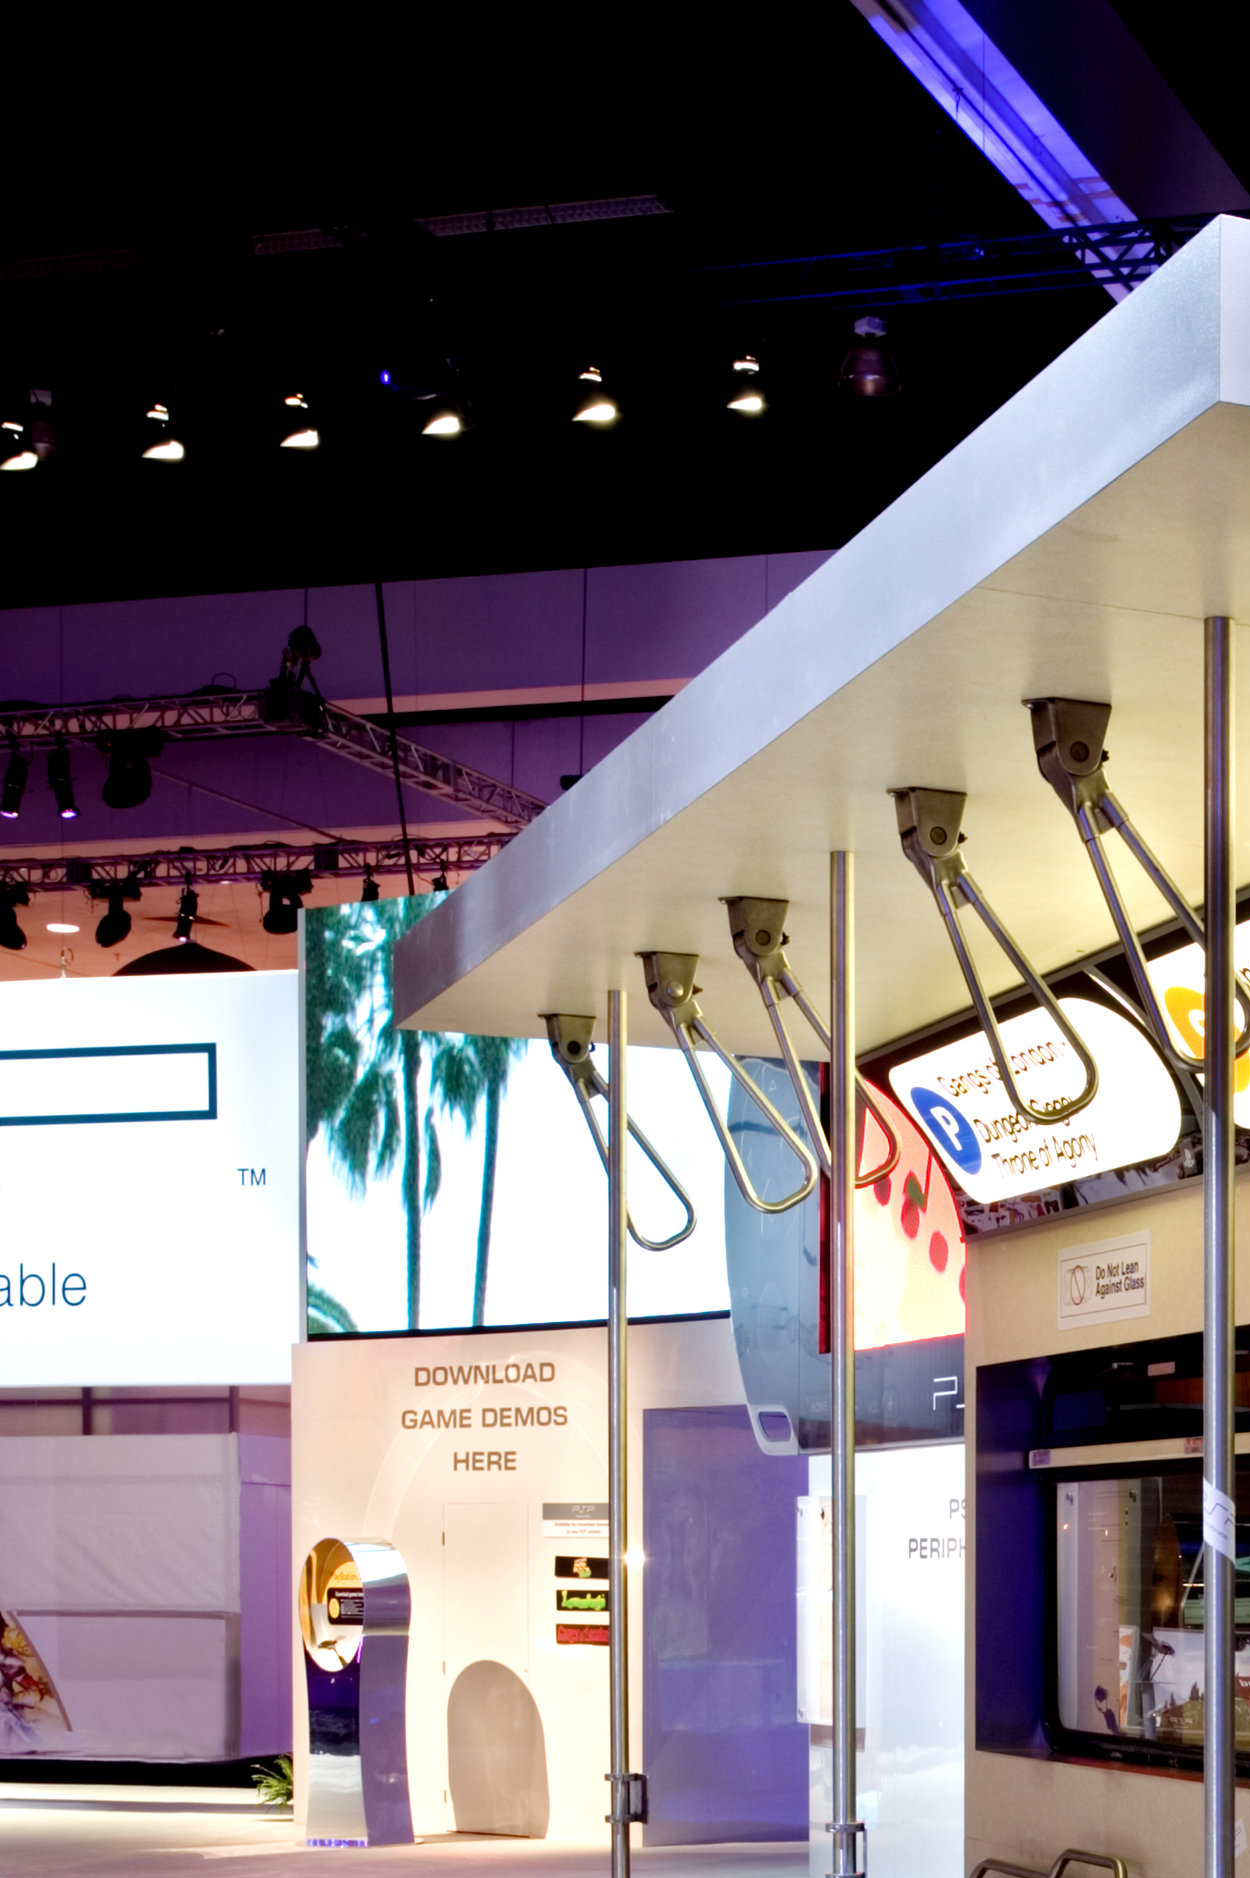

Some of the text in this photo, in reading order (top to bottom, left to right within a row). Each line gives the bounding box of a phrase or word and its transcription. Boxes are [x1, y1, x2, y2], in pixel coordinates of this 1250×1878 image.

[937, 1070, 991, 1097] Gangs
[930, 1106, 962, 1151] P
[991, 1132, 1098, 1178] Throne of Agony
[237, 1168, 267, 1186] TM
[1095, 1261, 1139, 1280] Do Not Lean
[0, 1262, 87, 1307] able
[1095, 1277, 1145, 1300] Against Glass
[414, 1362, 556, 1387] DOWNLOAD
[401, 1405, 569, 1430] GAME DEMOS
[453, 1451, 518, 1471] HERE
